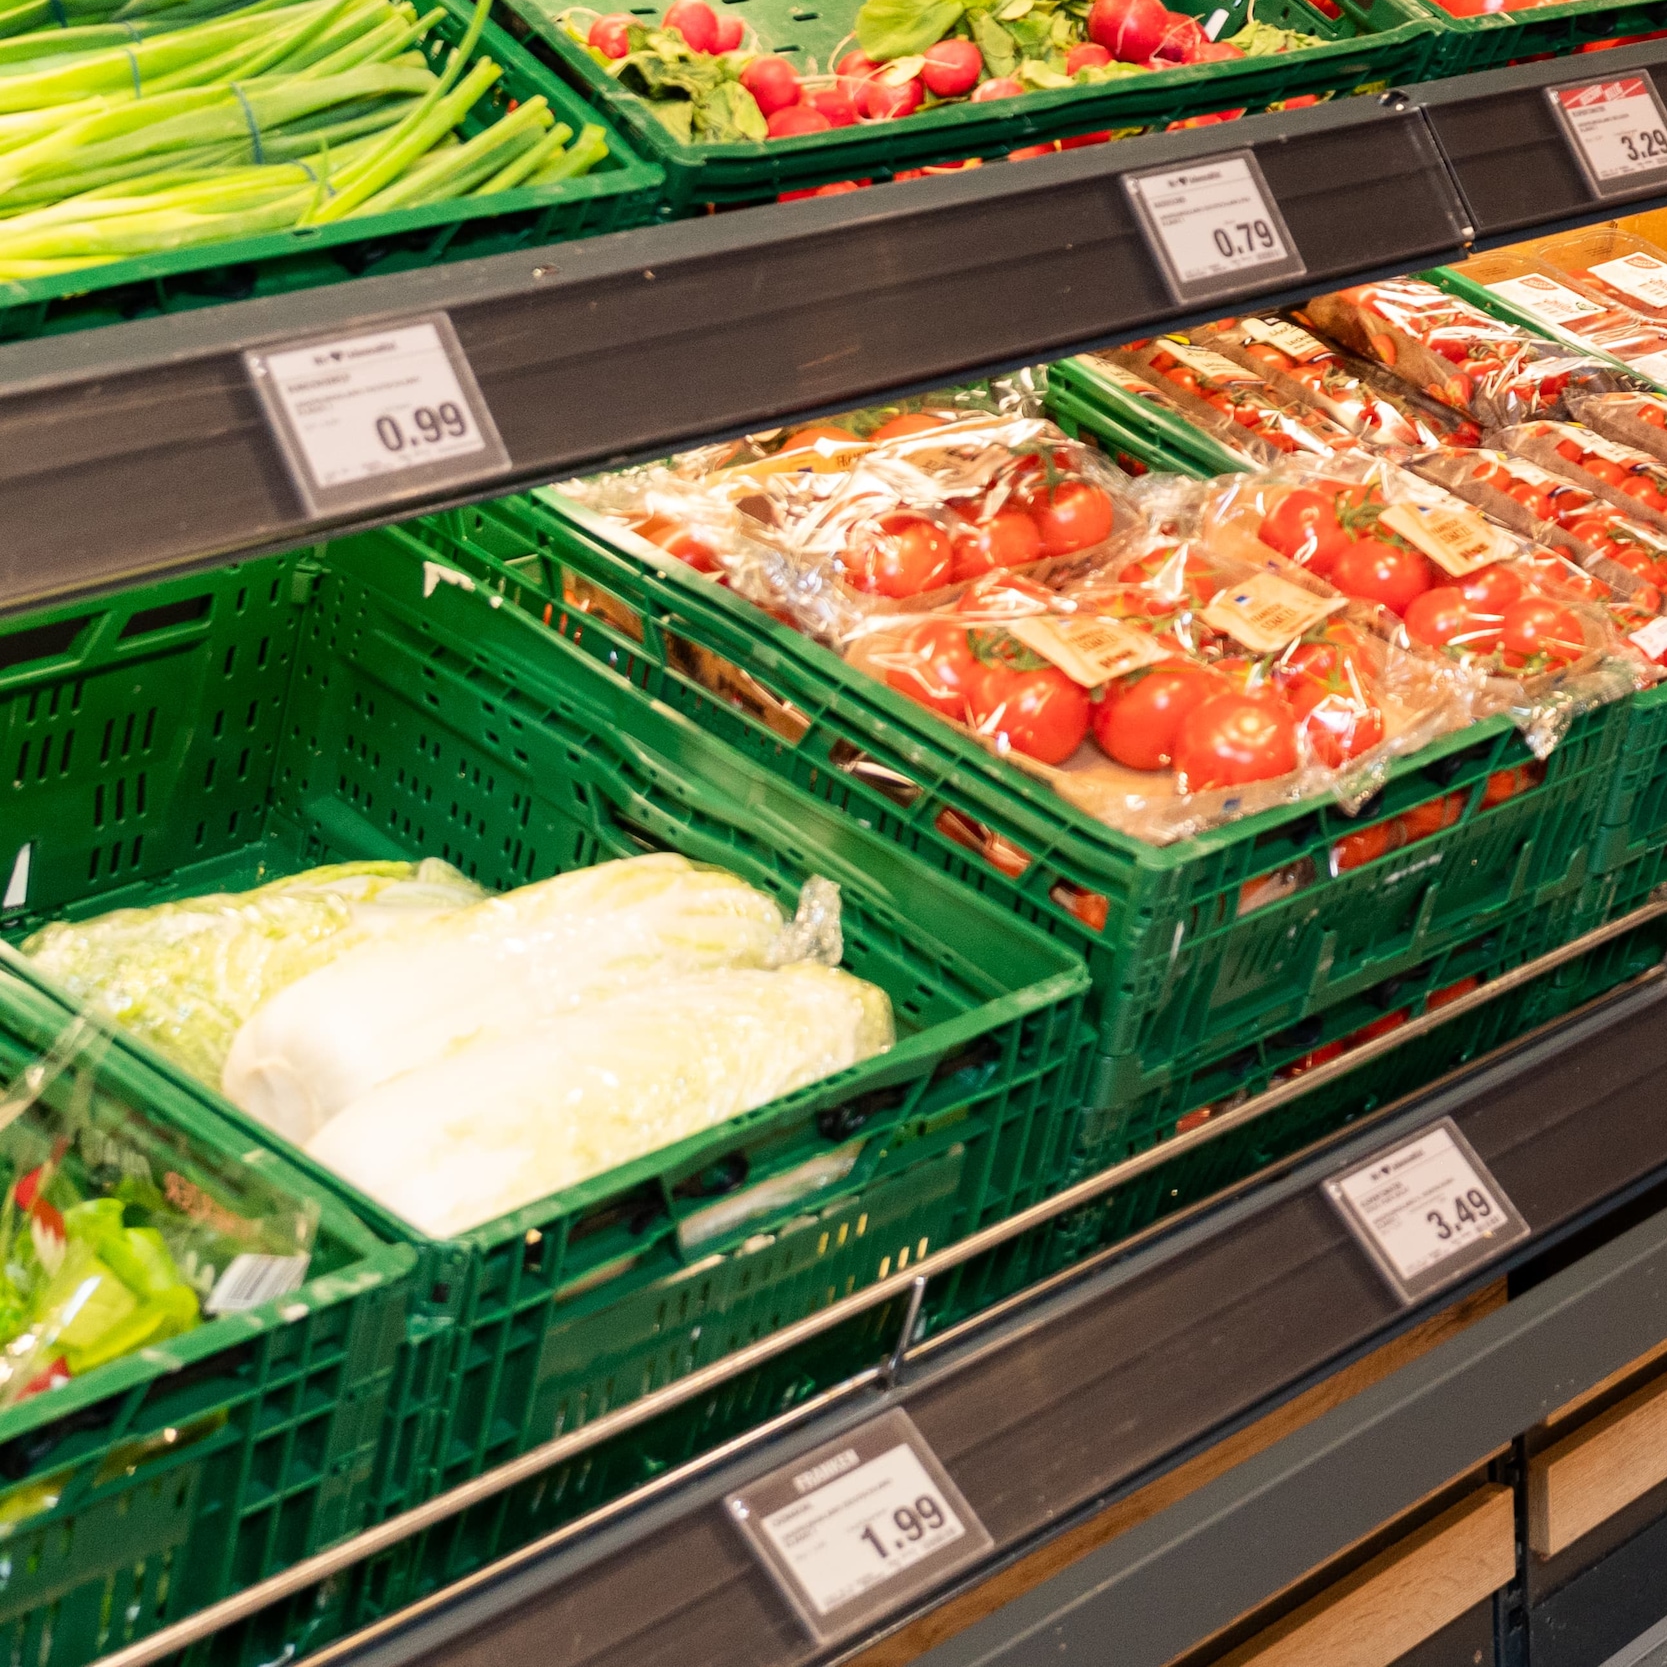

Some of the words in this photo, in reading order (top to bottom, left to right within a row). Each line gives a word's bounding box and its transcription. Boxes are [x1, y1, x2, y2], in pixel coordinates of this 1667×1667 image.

[1213, 218, 1274, 257] 0.79
[375, 400, 467, 452] 0.99
[1426, 1189, 1492, 1240] 3.49
[860, 1494, 945, 1559] 1.99
